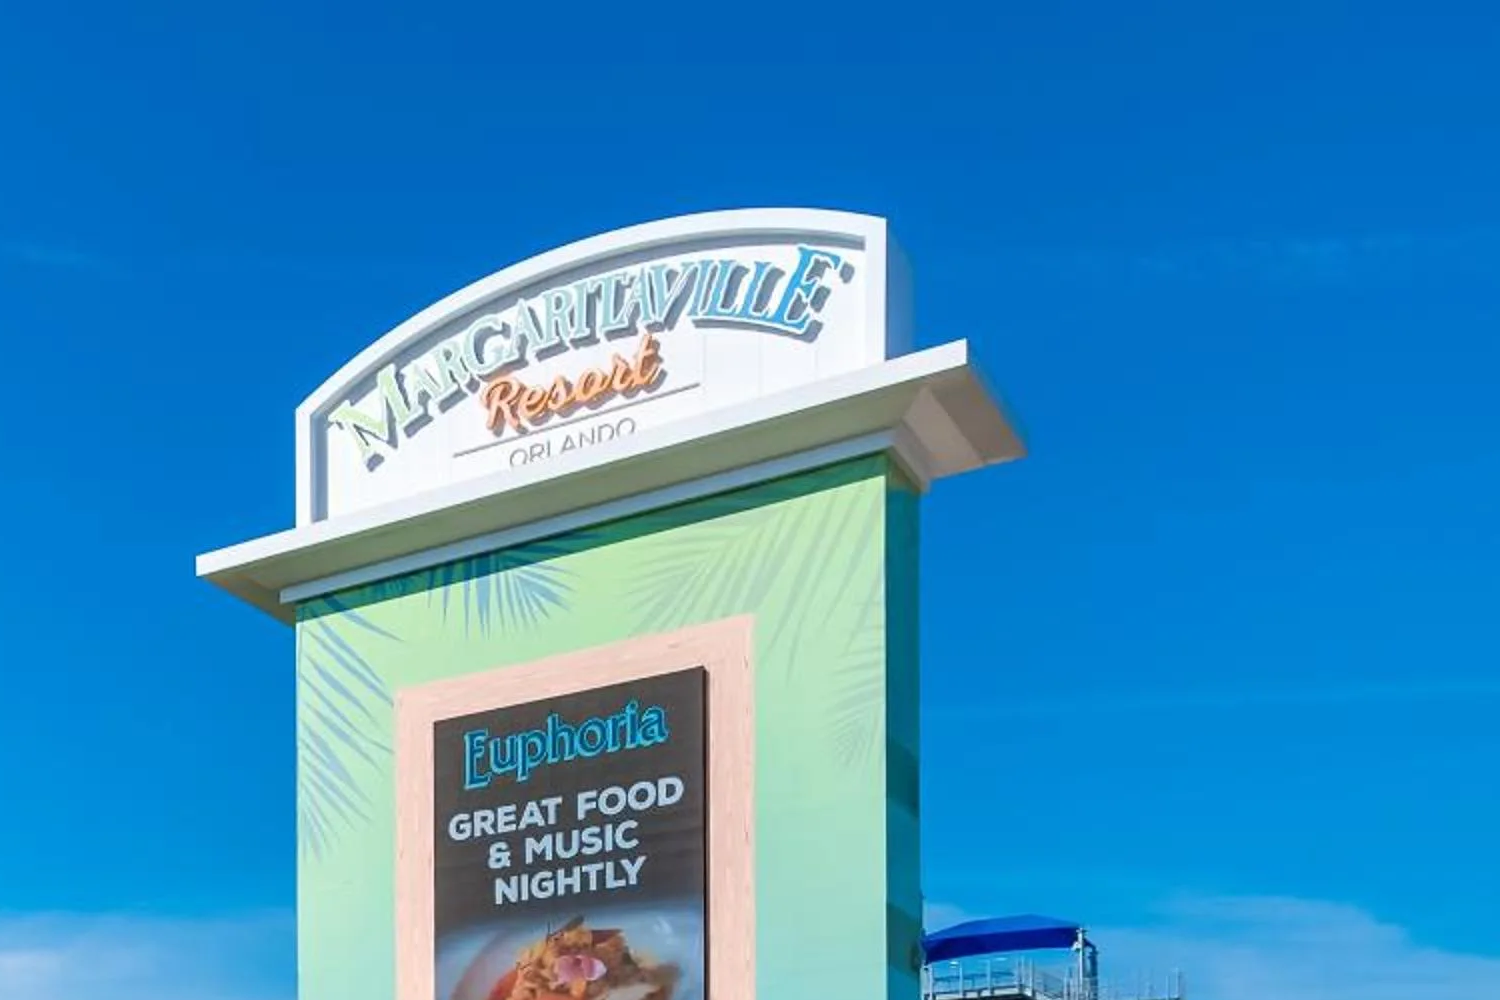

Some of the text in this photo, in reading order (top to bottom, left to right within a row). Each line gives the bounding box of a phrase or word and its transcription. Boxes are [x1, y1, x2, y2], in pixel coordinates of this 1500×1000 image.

[328, 244, 848, 464] MARGARITAVILLE
[480, 334, 664, 436] Resort
[463, 701, 668, 790] Euphoria
[449, 776, 685, 841] GREAT FOOD
[488, 820, 639, 869] & MUSIC
[495, 856, 647, 905] NIGHTLY
